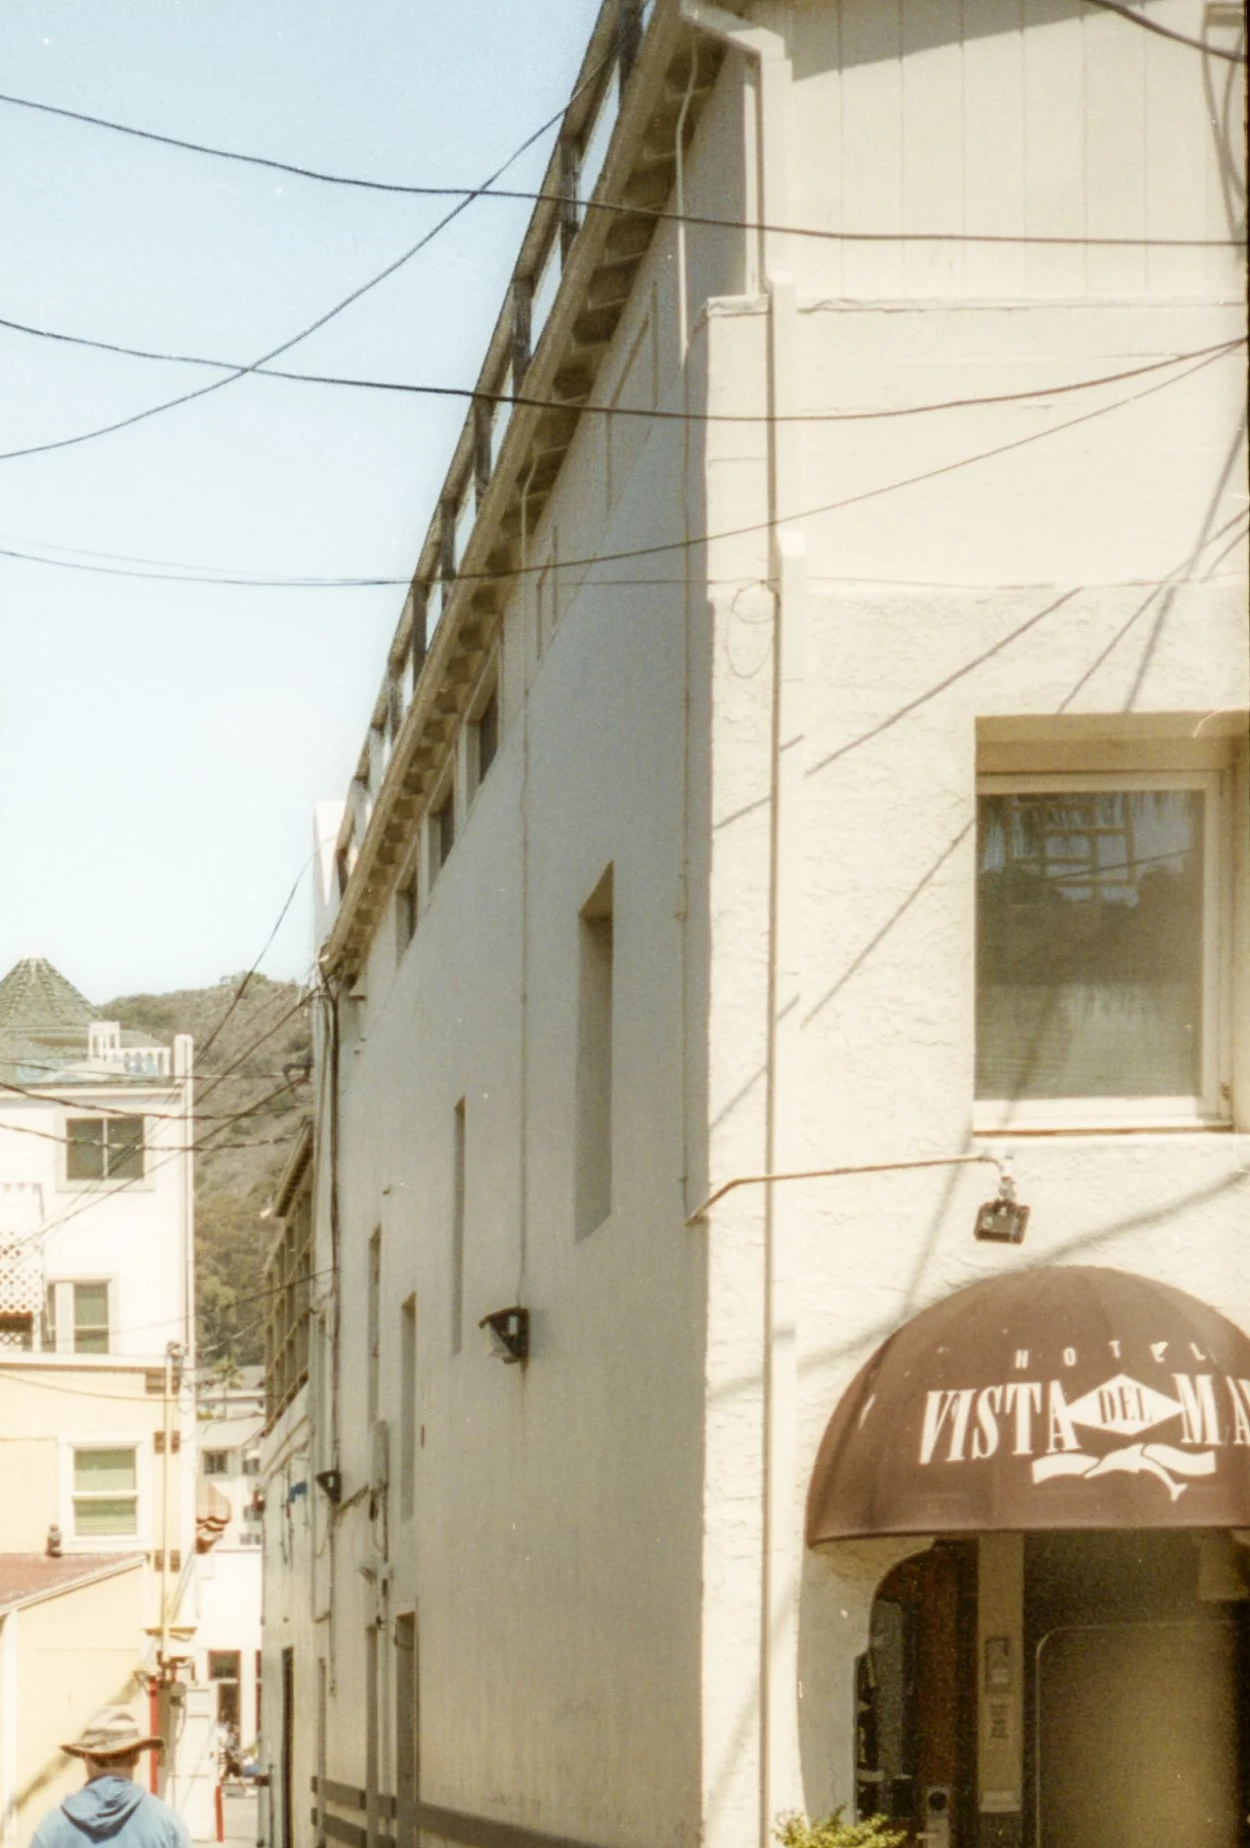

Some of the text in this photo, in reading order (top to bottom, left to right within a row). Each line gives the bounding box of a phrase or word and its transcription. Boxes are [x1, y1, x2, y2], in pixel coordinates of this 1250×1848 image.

[1014, 1340, 1207, 1370] HOTEL
[918, 1379, 1083, 1465] VISTA
[1097, 1385, 1154, 1426] DEL
